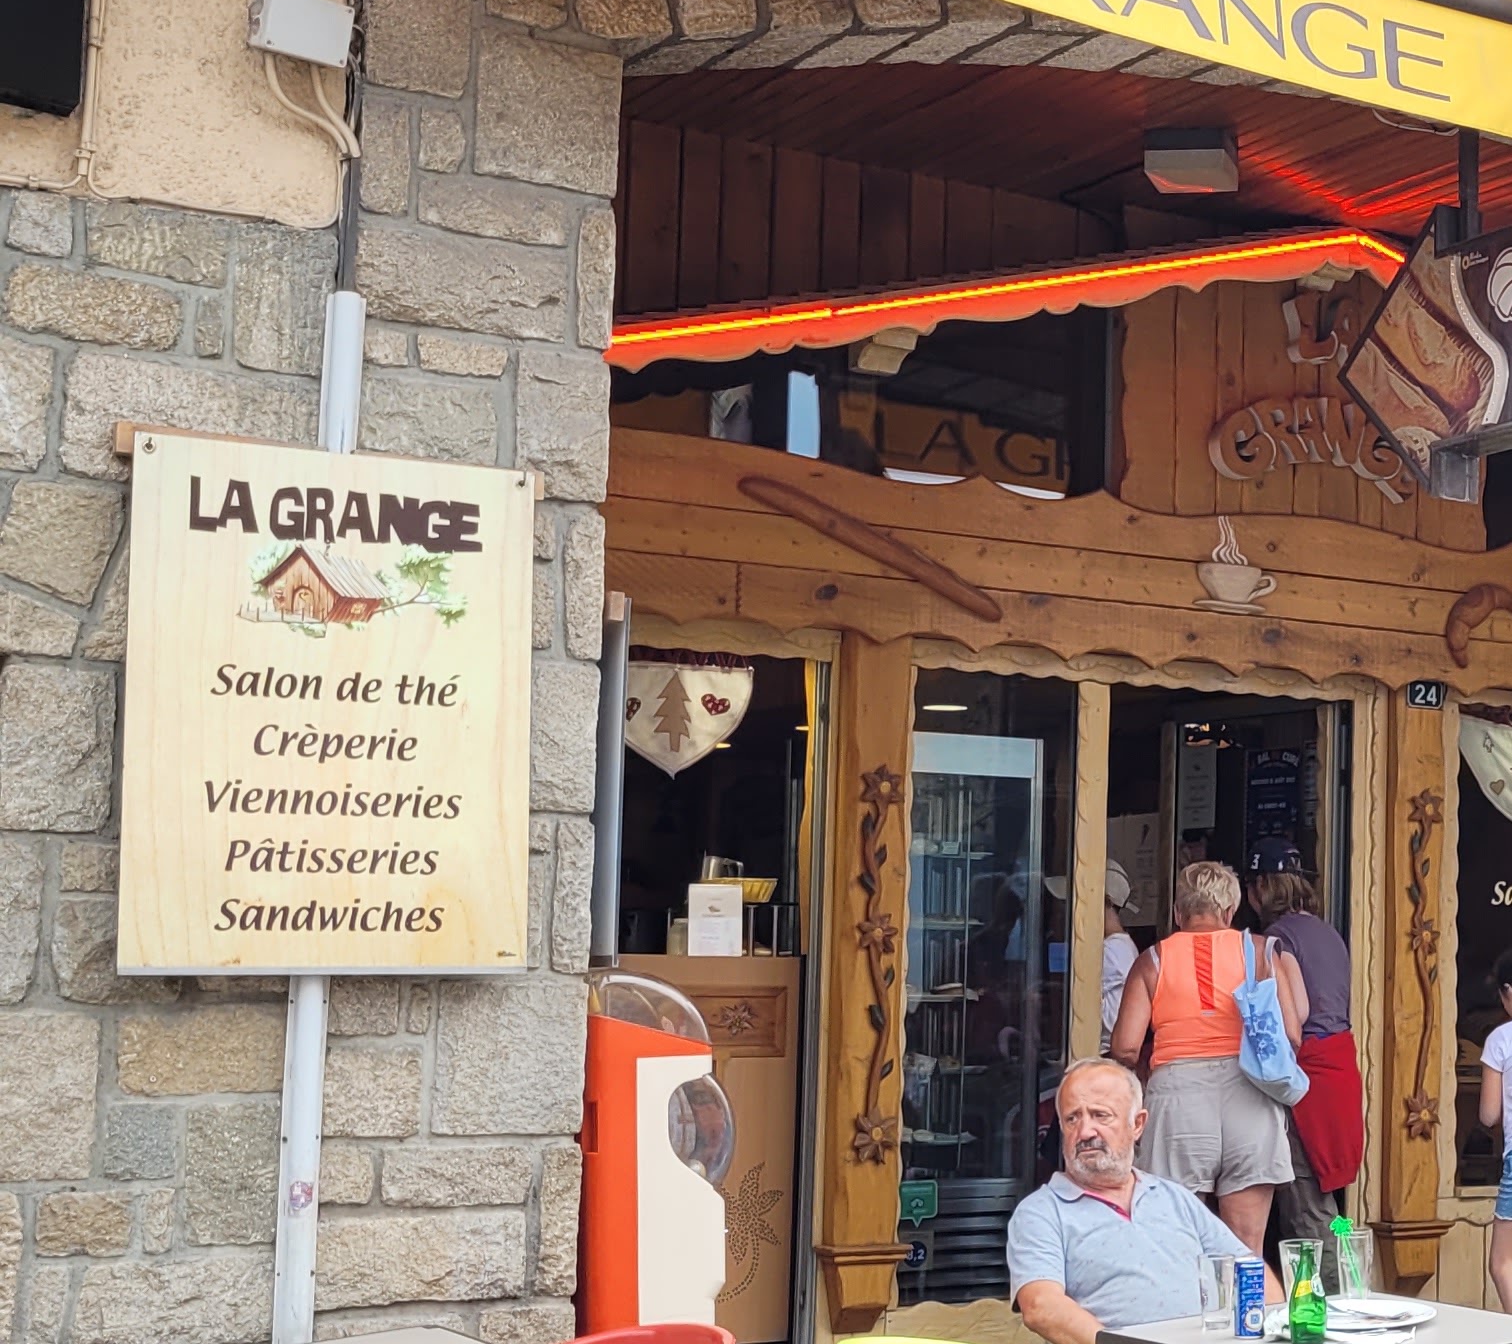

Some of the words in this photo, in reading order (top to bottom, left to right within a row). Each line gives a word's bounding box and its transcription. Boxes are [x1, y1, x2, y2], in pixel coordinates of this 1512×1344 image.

[190, 475, 259, 534] LA
[269, 487, 483, 554] GRANGE
[210, 663, 323, 700] Salon
[336, 672, 383, 703] de
[395, 674, 461, 707] thé
[1414, 683, 1438, 706] 24
[253, 723, 418, 764] Crèperie
[203, 780, 462, 821] Viennoiseries
[224, 838, 440, 877] Pâtisseries
[213, 896, 445, 934] Sandwiches
